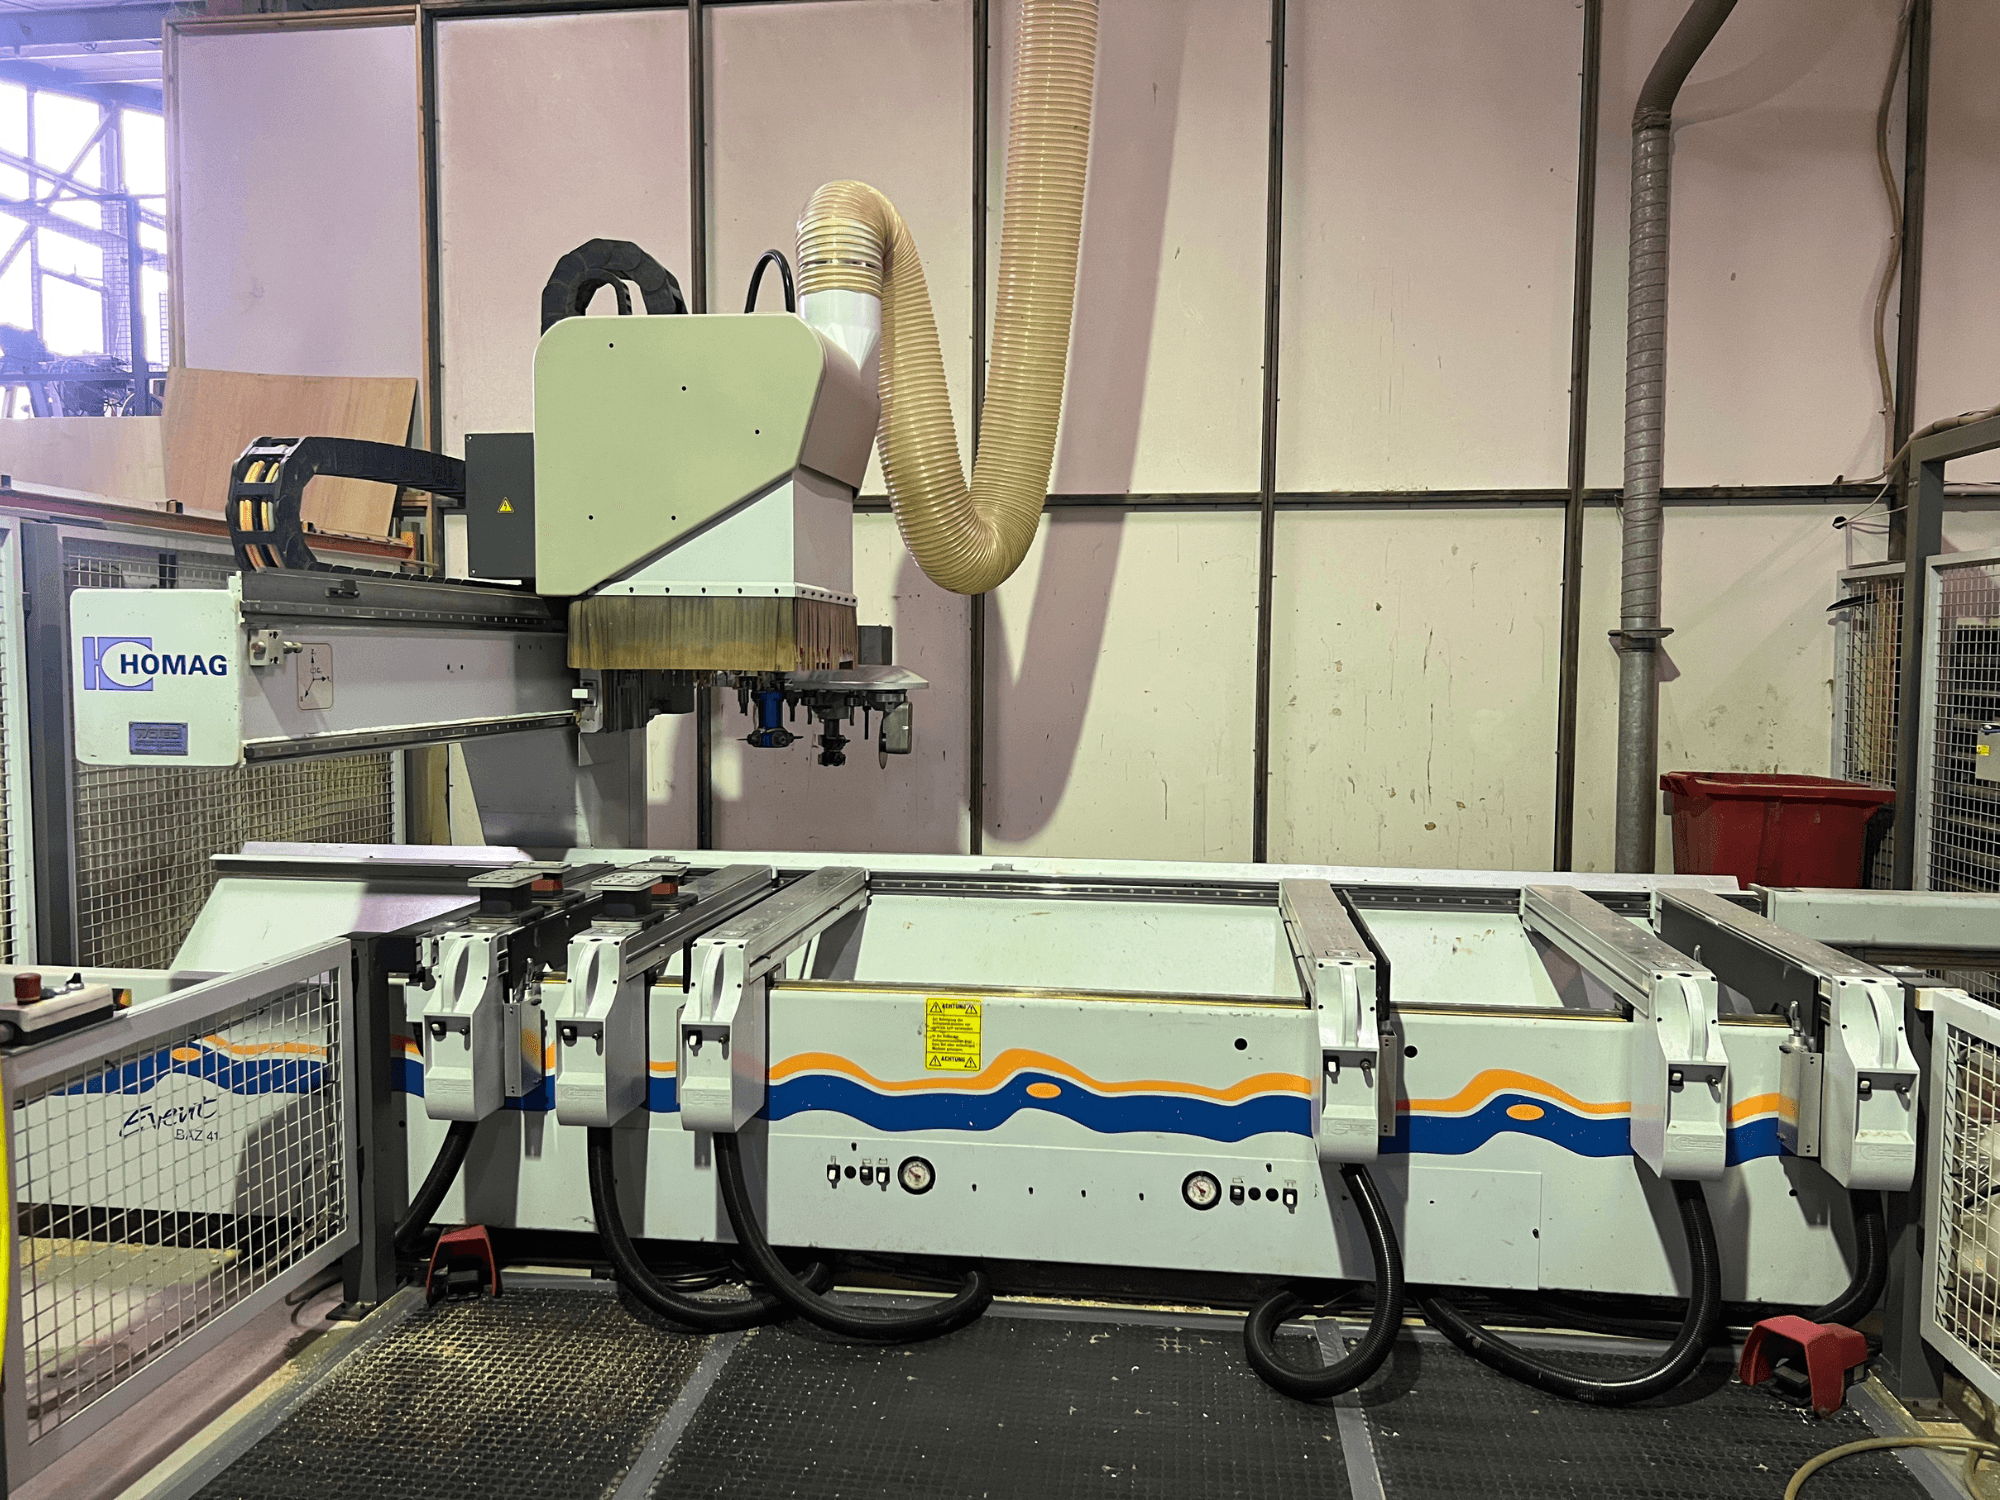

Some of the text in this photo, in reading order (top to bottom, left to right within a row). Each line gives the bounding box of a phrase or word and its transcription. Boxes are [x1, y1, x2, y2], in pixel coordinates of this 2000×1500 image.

[120, 653, 228, 676] HOMAG
[119, 1096, 217, 1138] Event
[175, 1129, 219, 1142] BAZ 41
